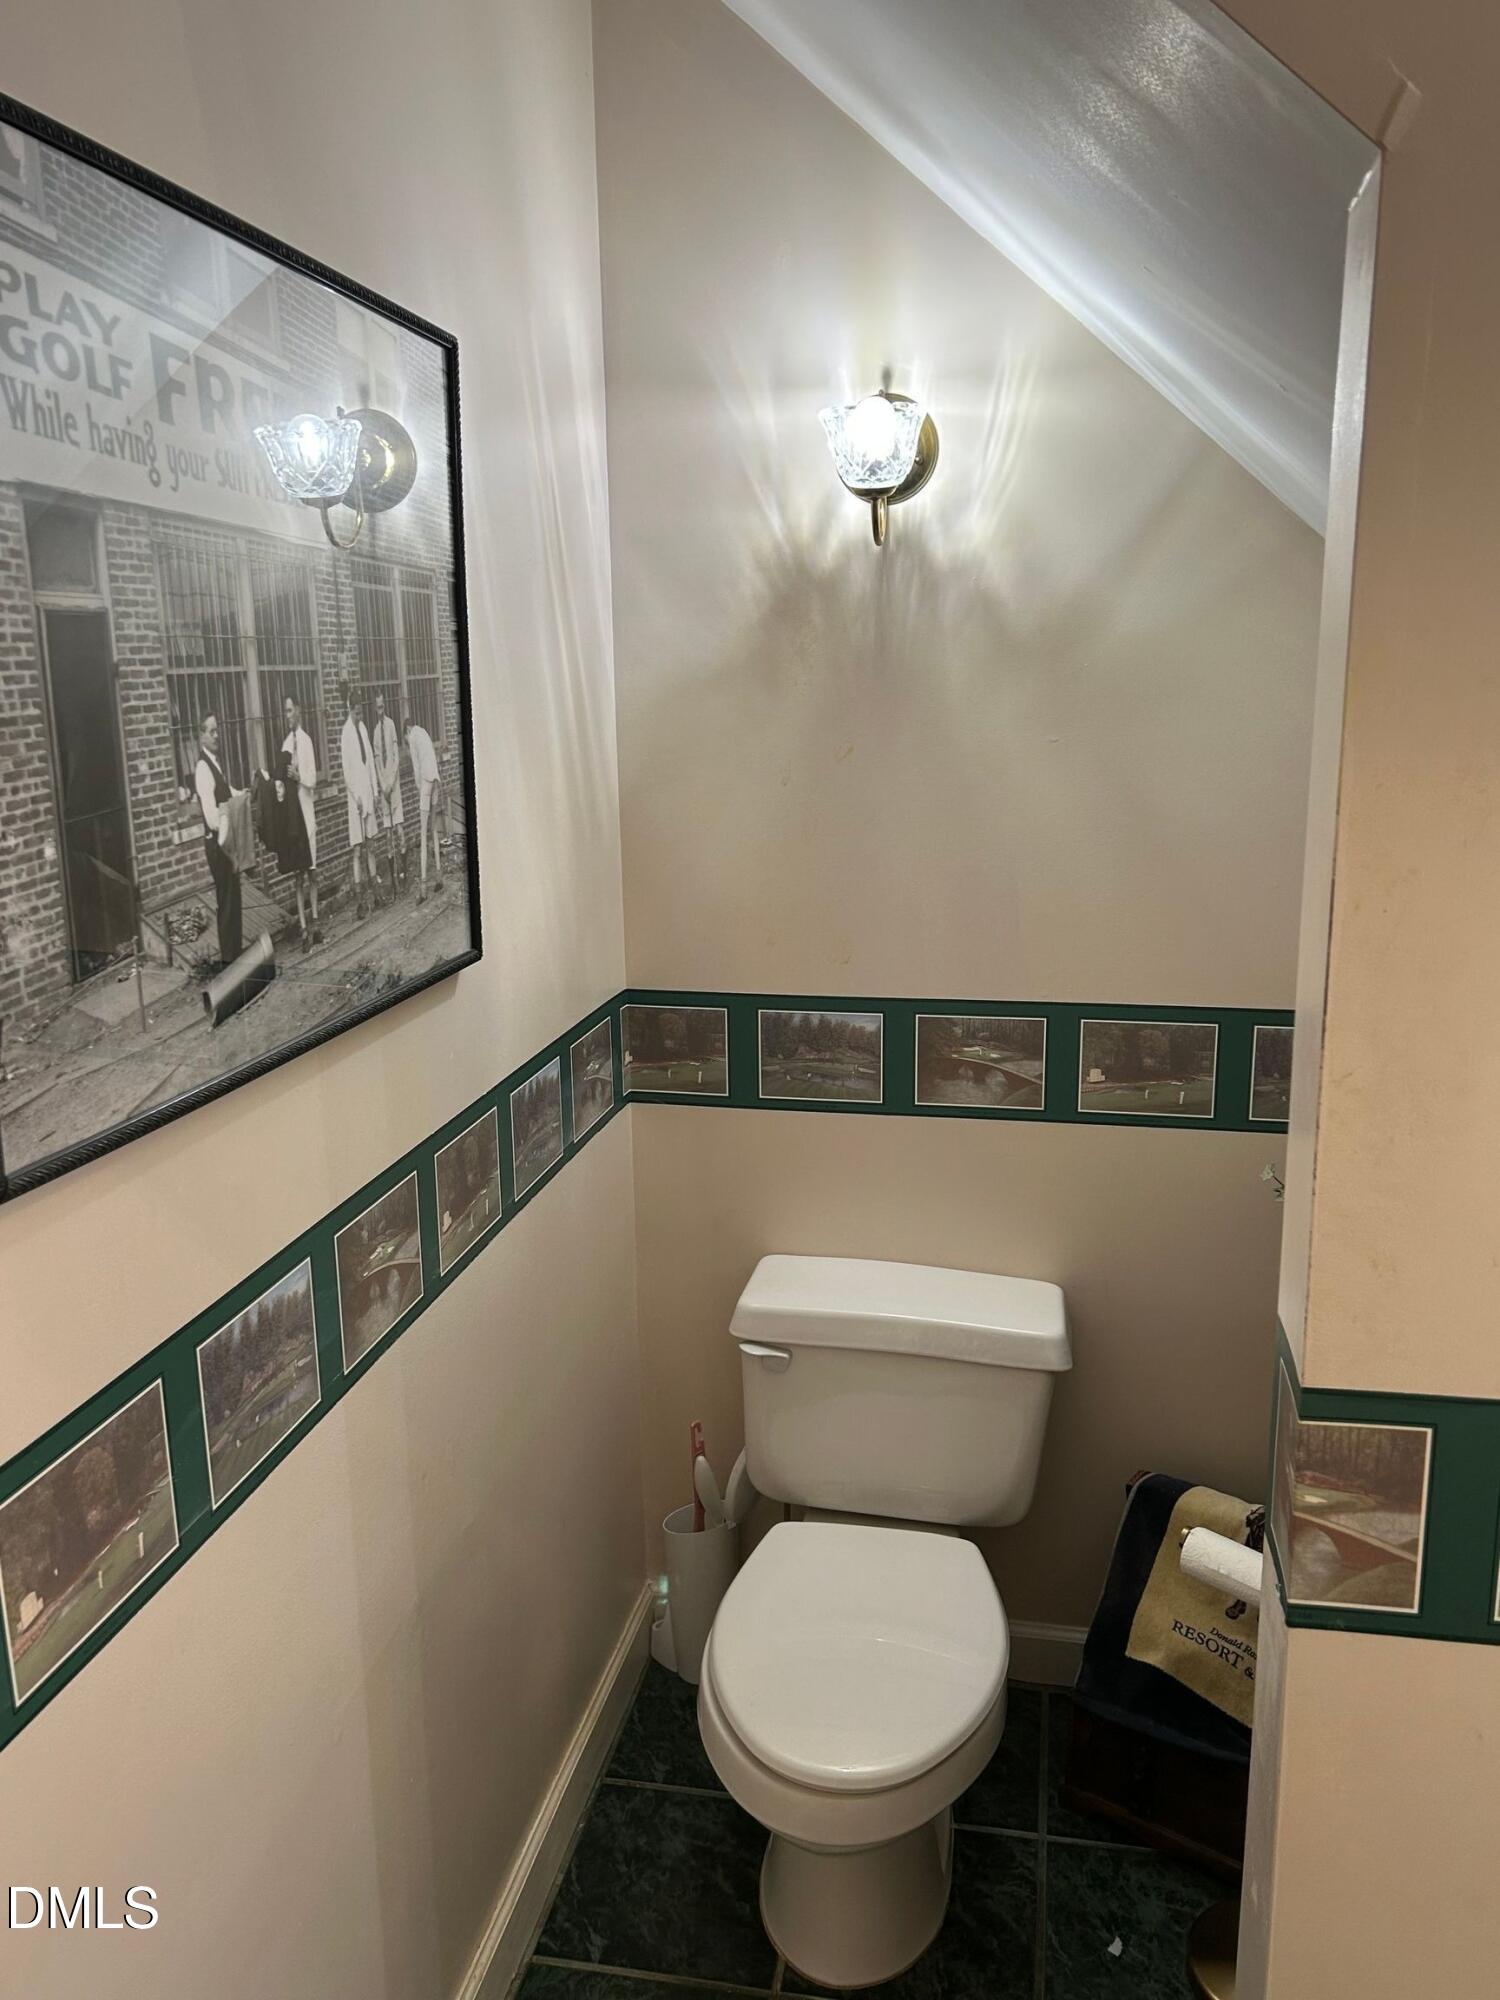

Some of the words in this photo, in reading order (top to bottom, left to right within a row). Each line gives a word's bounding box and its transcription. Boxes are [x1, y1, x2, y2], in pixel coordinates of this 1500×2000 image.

[0, 260, 121, 347] PLAY
[0, 314, 133, 400] GOLF
[0, 372, 80, 448] While
[86, 402, 161, 487] having
[165, 442, 208, 492] your
[1172, 1619, 1244, 1669] RESORT
[1244, 1667, 1256, 1680] &
[1210, 1627, 1243, 1650] Donald
